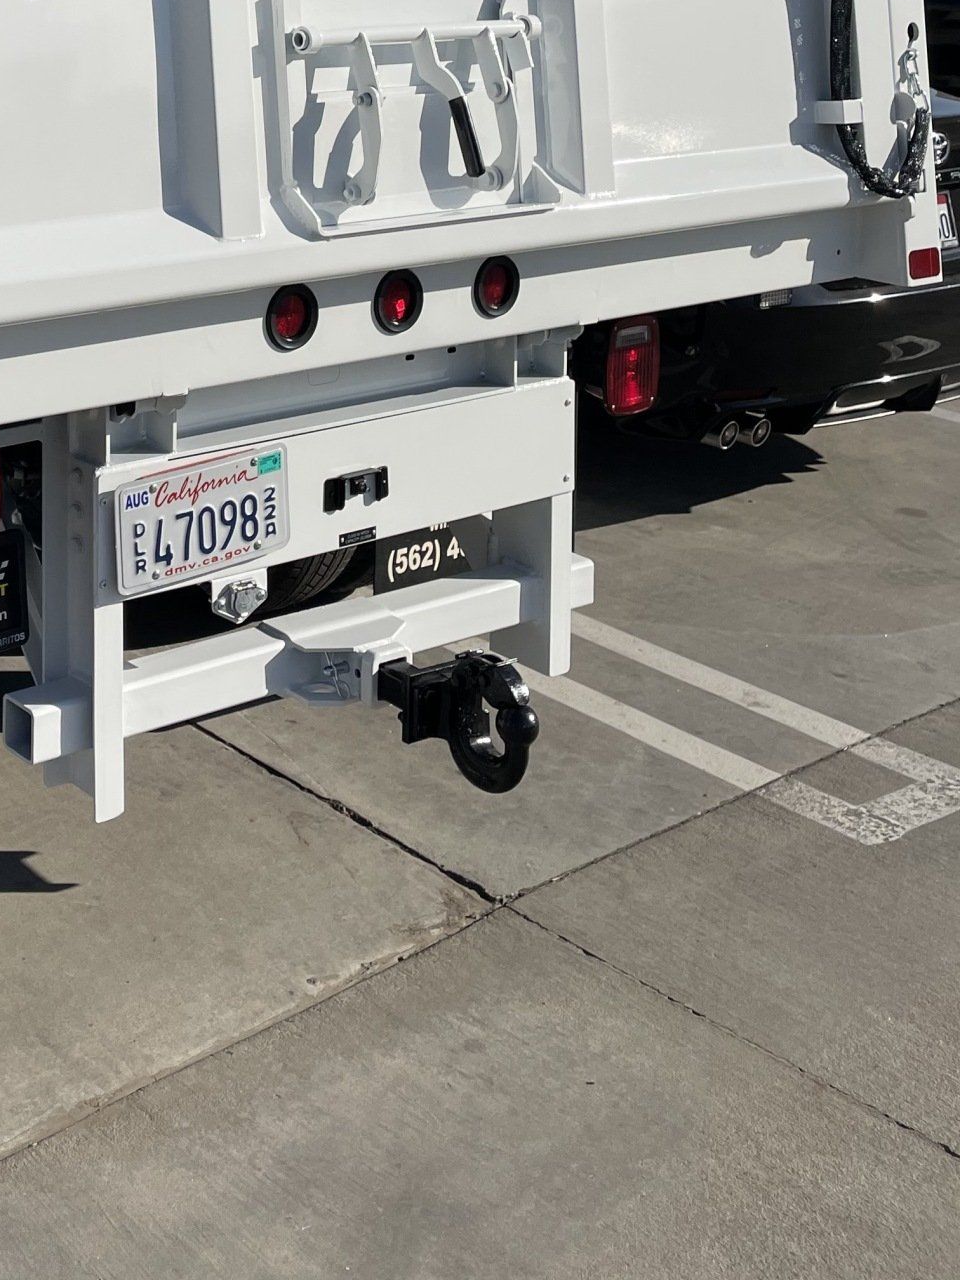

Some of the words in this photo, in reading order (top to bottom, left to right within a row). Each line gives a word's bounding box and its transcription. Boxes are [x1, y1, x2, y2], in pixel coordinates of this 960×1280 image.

[125, 491, 149, 510] AUG
[155, 465, 258, 508] California
[154, 494, 259, 566] 47098
[164, 545, 251, 577] dmv.ca.gov
[387, 539, 441, 583] (562)
